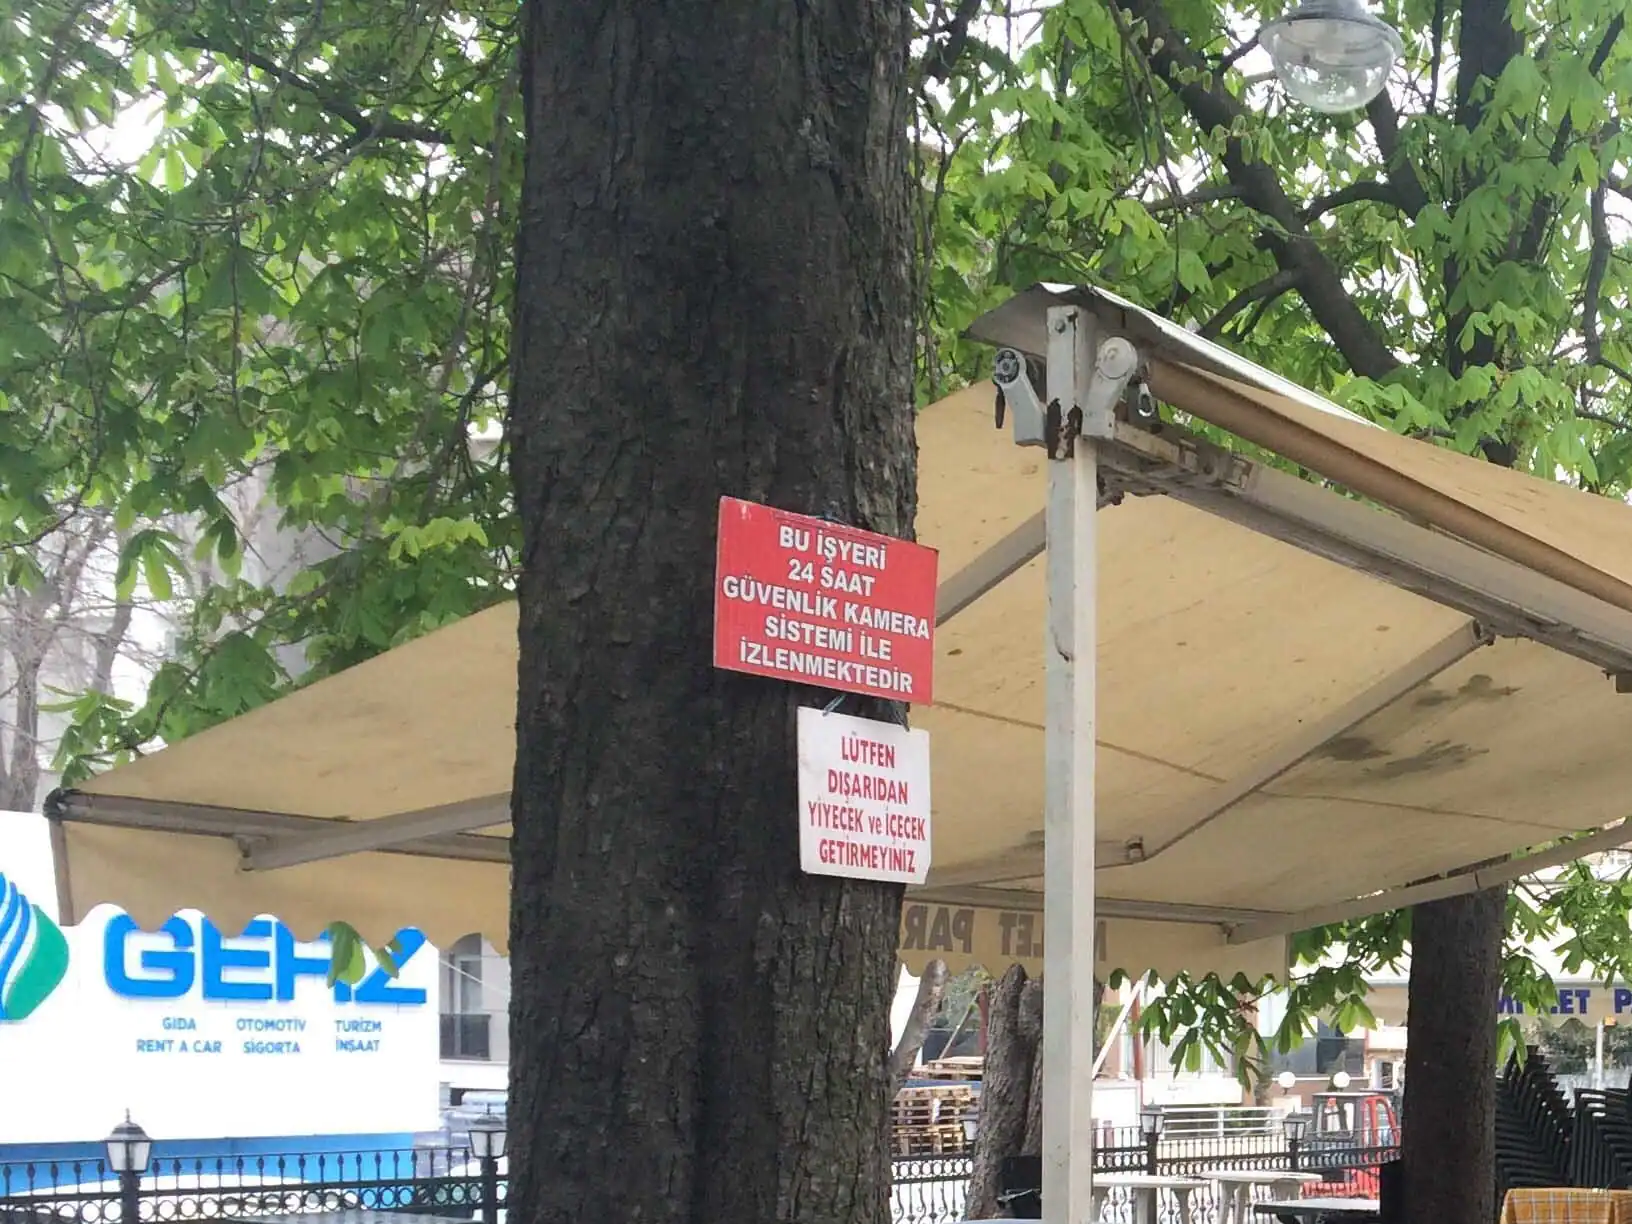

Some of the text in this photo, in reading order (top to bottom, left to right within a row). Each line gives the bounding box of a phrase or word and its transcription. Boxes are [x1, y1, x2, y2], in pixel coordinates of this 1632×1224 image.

[779, 525, 887, 570] BU İŞYERİ
[788, 558, 875, 597] 24 SAAT
[722, 575, 930, 640] GÜVENLİK KAMERA
[765, 613, 892, 661] SİSTEMİ İLE
[739, 636, 913, 694] İZLENMEKTEDİR
[841, 731, 896, 769] LÜTFEN
[828, 769, 908, 806] DIŞARIDAN
[868, 815, 882, 836] ve
[162, 1016, 382, 1033] GIDA OTOMOTİV TURİZM
[136, 1039, 174, 1053] RENT
[179, 1039, 188, 1053] A
[193, 1040, 222, 1053] CAR
[243, 1037, 301, 1054] SİGORTA
